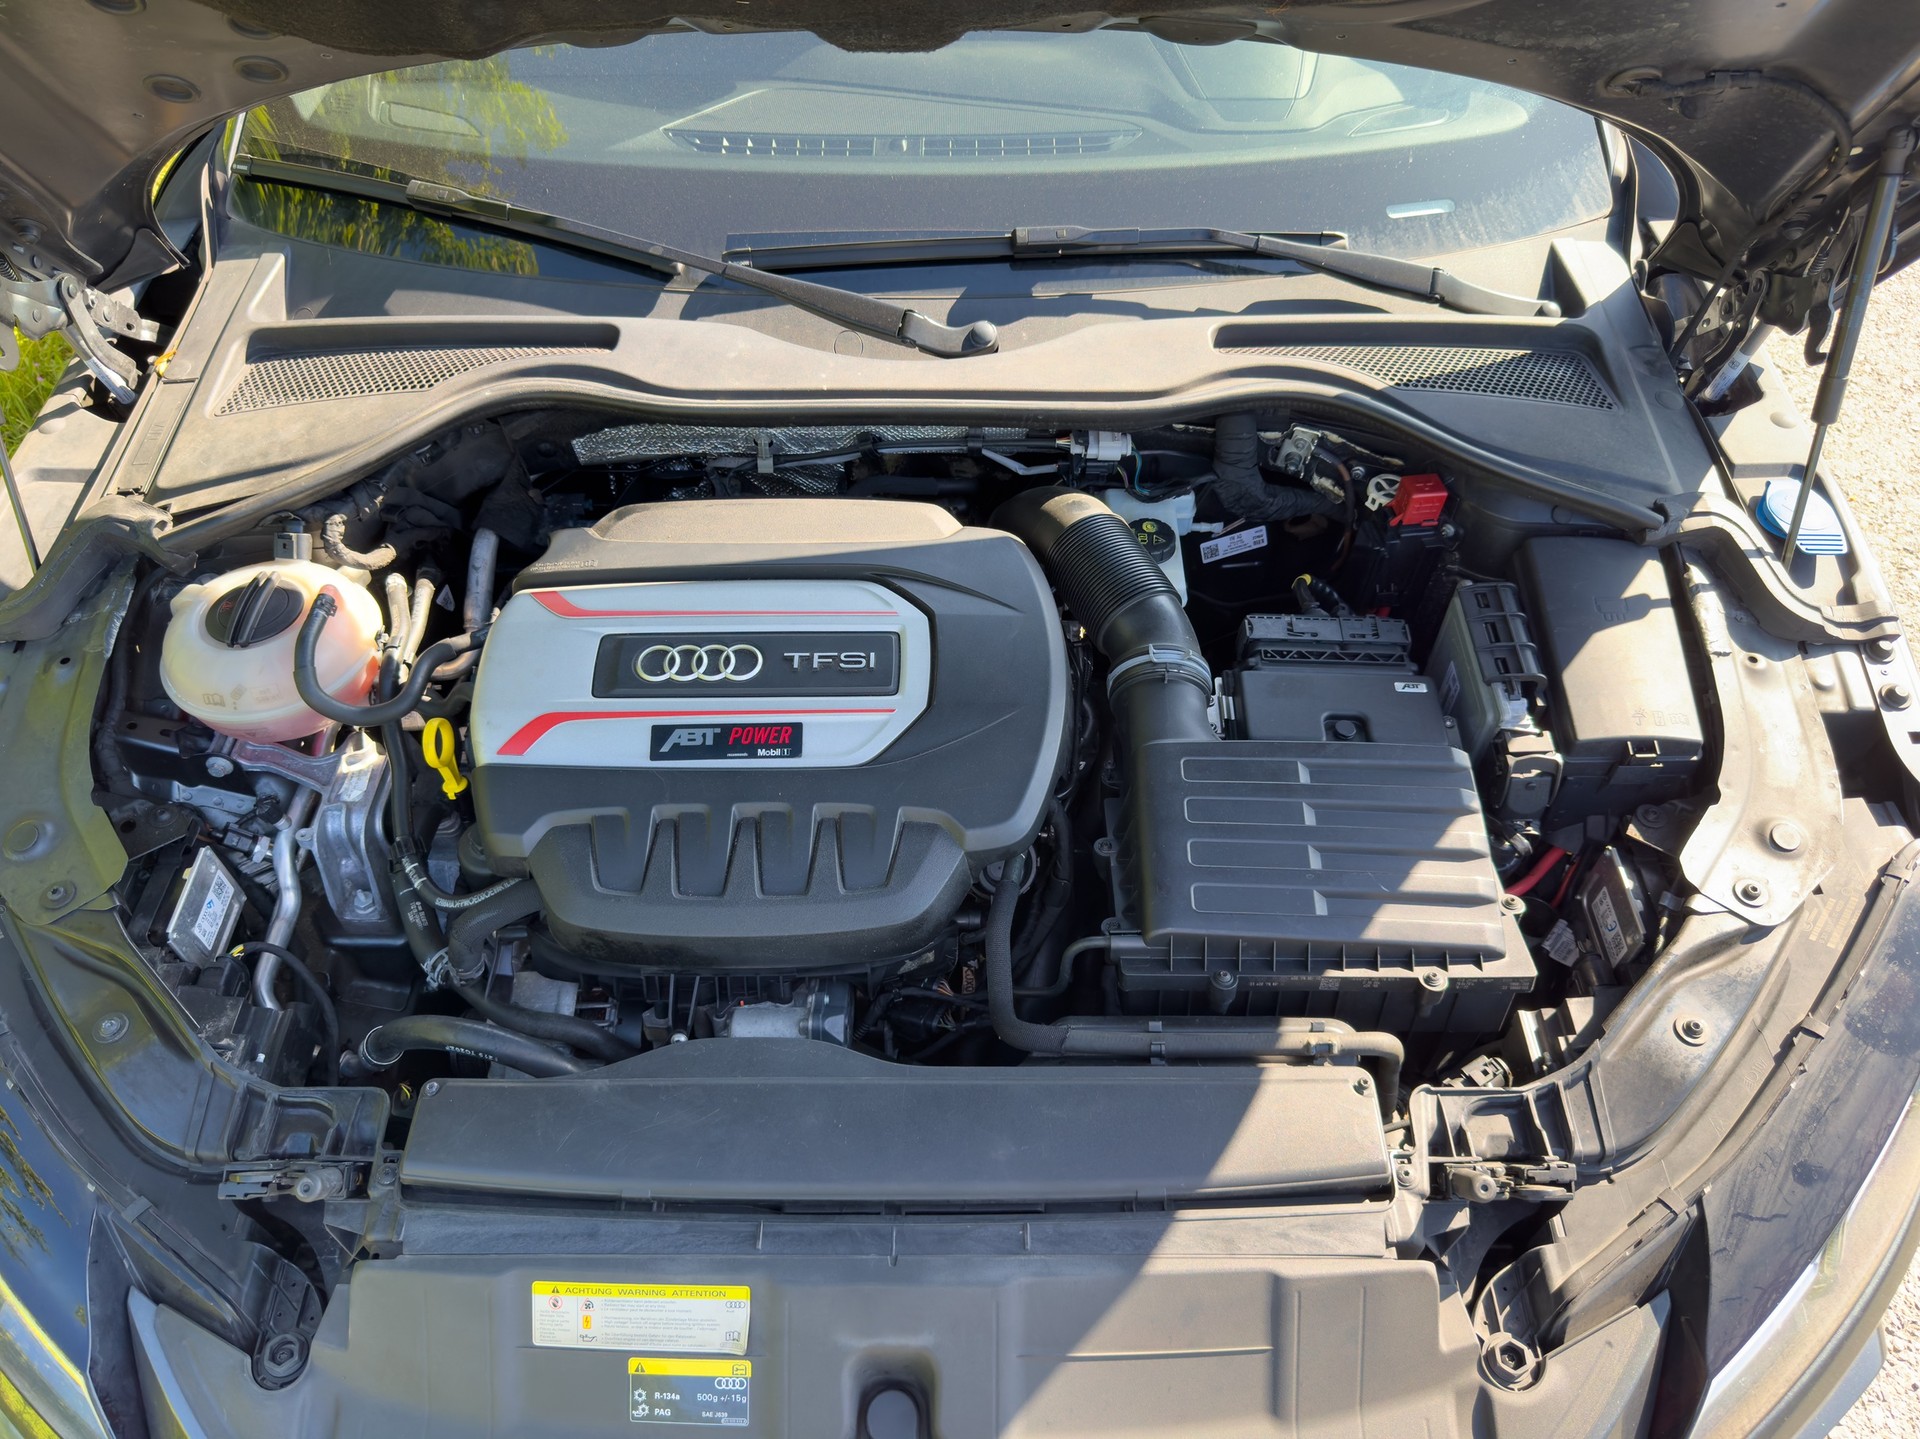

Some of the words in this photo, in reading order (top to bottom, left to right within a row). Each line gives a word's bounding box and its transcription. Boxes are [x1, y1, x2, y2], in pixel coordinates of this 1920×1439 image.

[783, 651, 877, 671] TFSI
[659, 727, 721, 753] ABT
[728, 726, 793, 745] POWER
[757, 748, 781, 757] Mobil
[564, 1287, 613, 1296] ACHTUNG
[617, 1288, 667, 1297] WARNING
[671, 1290, 727, 1298] ATTENTION
[654, 1392, 681, 1401] R-134a
[696, 1393, 718, 1403] 500g
[654, 1408, 671, 1416] PAG
